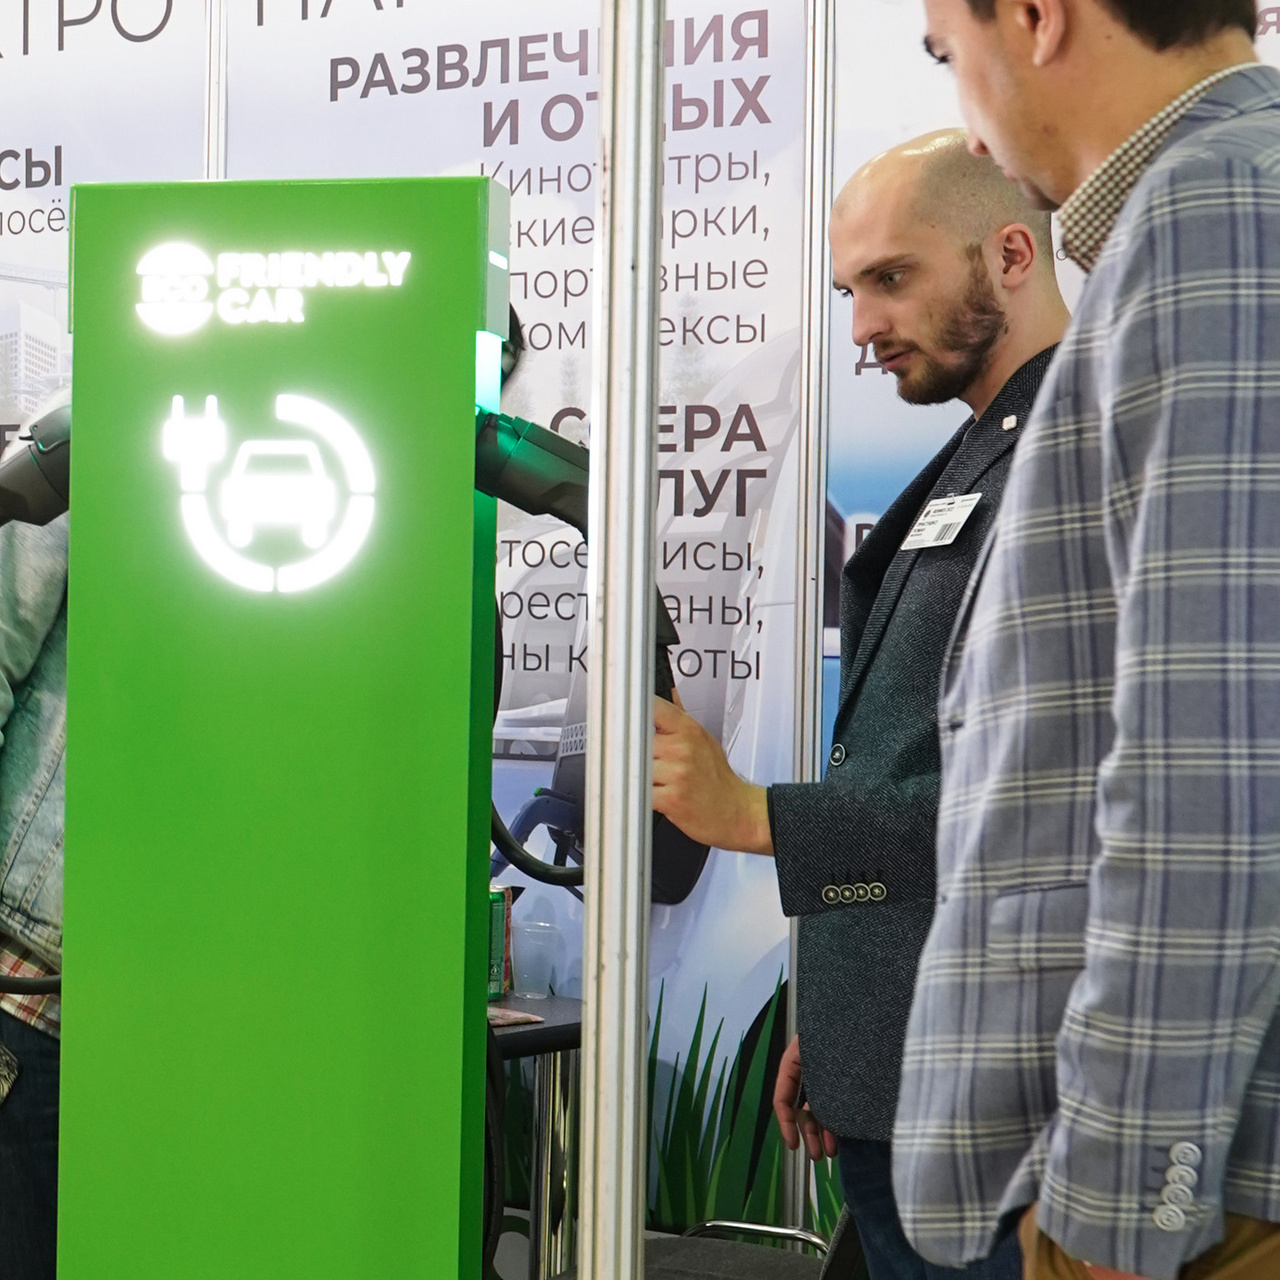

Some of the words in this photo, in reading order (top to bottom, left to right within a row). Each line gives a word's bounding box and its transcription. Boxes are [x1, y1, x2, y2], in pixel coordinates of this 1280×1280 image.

[329, 9, 769, 102] РАЗВЛЕЧИЯ
[483, 99, 519, 148] И
[540, 75, 772, 142] ОЫХ
[218, 252, 412, 287] FRIENDLY
[218, 287, 305, 324] CAR
[656, 468, 768, 517] ЛУГ
